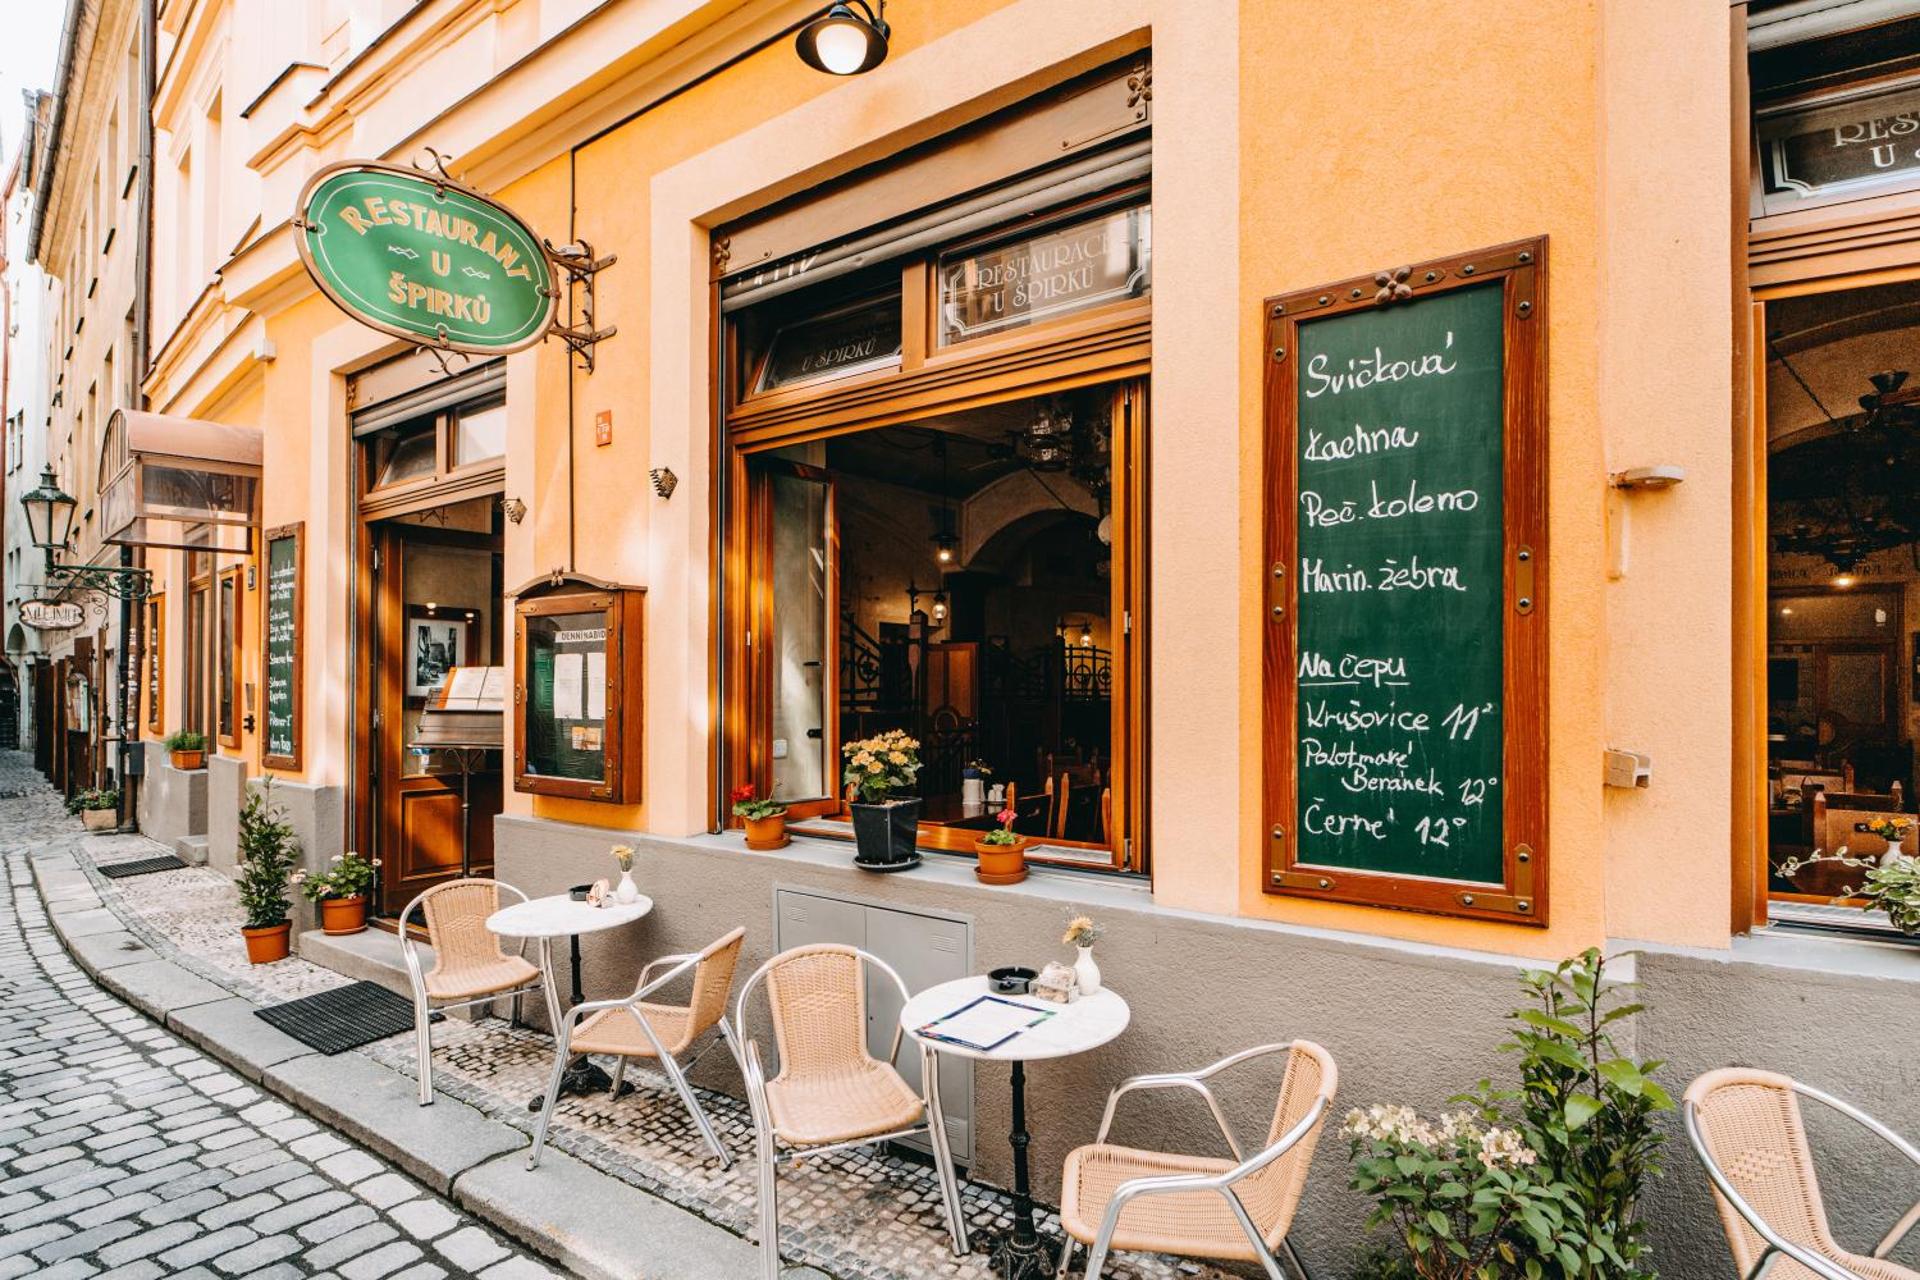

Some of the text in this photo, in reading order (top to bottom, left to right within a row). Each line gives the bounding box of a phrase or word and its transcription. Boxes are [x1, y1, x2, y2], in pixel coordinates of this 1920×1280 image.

[1832, 110, 1920, 148] RES
[1869, 143, 1896, 168] U
[338, 197, 533, 282] RESTAURANT
[431, 250, 451, 277] U
[388, 271, 491, 325] ŠPIRKŮ
[993, 291, 1005, 313] U
[1302, 555, 1467, 593] Marin. žebra
[1298, 651, 1336, 678] Na
[1306, 700, 1430, 731] Krušovice
[1305, 797, 1395, 840] Černé
